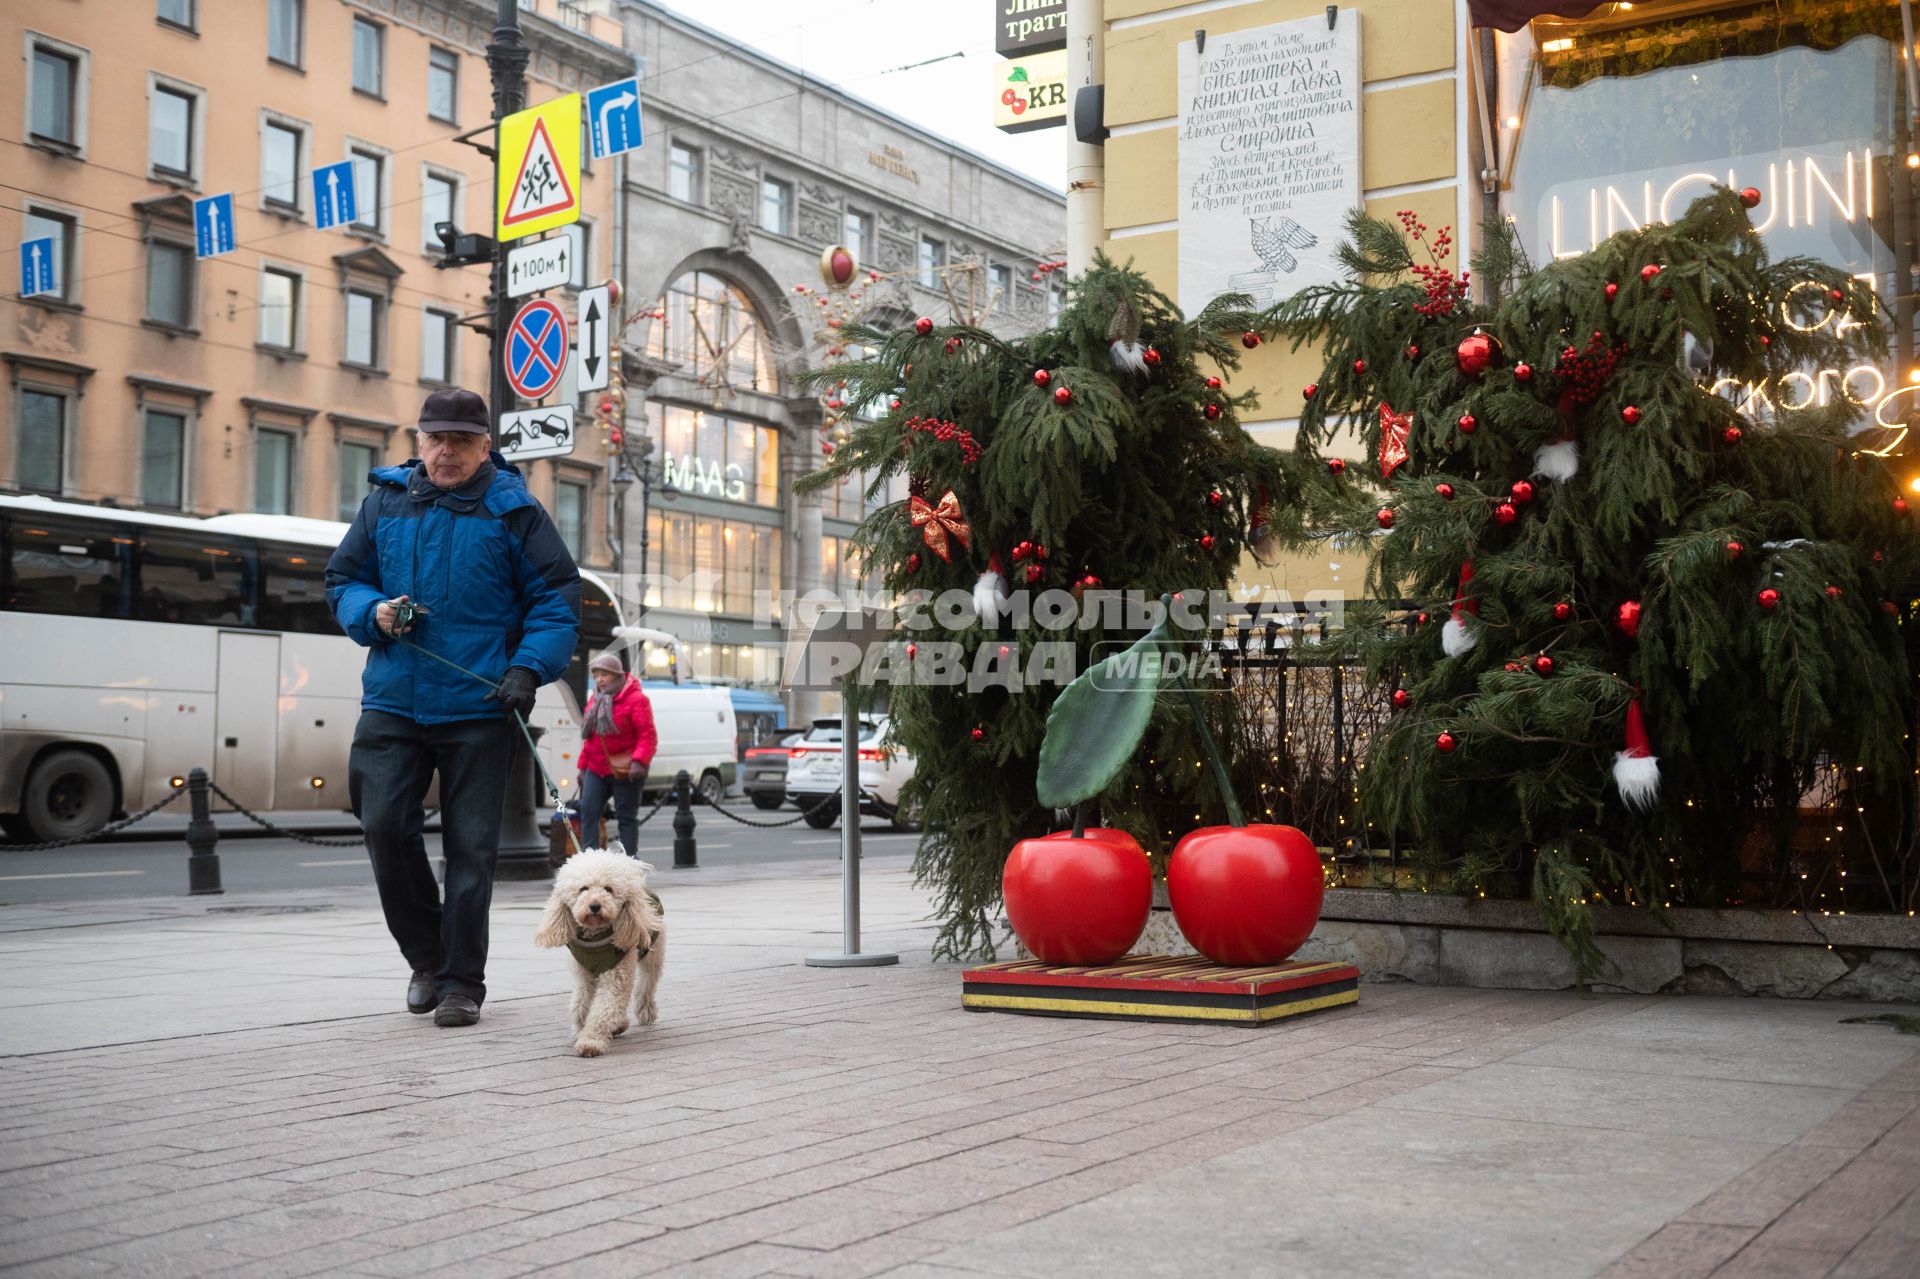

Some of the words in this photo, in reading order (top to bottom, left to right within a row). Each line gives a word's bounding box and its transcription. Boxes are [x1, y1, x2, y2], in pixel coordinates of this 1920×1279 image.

[1005, 11, 1067, 42] тратт
[1237, 39, 1268, 54] этом
[1271, 33, 1304, 47] доме
[1270, 38, 1337, 60] находились
[1028, 82, 1066, 110] KR
[1187, 105, 1250, 127] известного
[1254, 89, 1345, 114] книгоиздателя
[1179, 117, 1257, 140] Александра
[1259, 100, 1353, 128] Филипповича
[1220, 122, 1315, 152] Смирдина
[1244, 141, 1319, 164] встречались
[1203, 194, 1240, 212] другие
[1242, 187, 1286, 206] русские
[1253, 199, 1293, 214] поэты
[664, 450, 745, 500] MAAG
